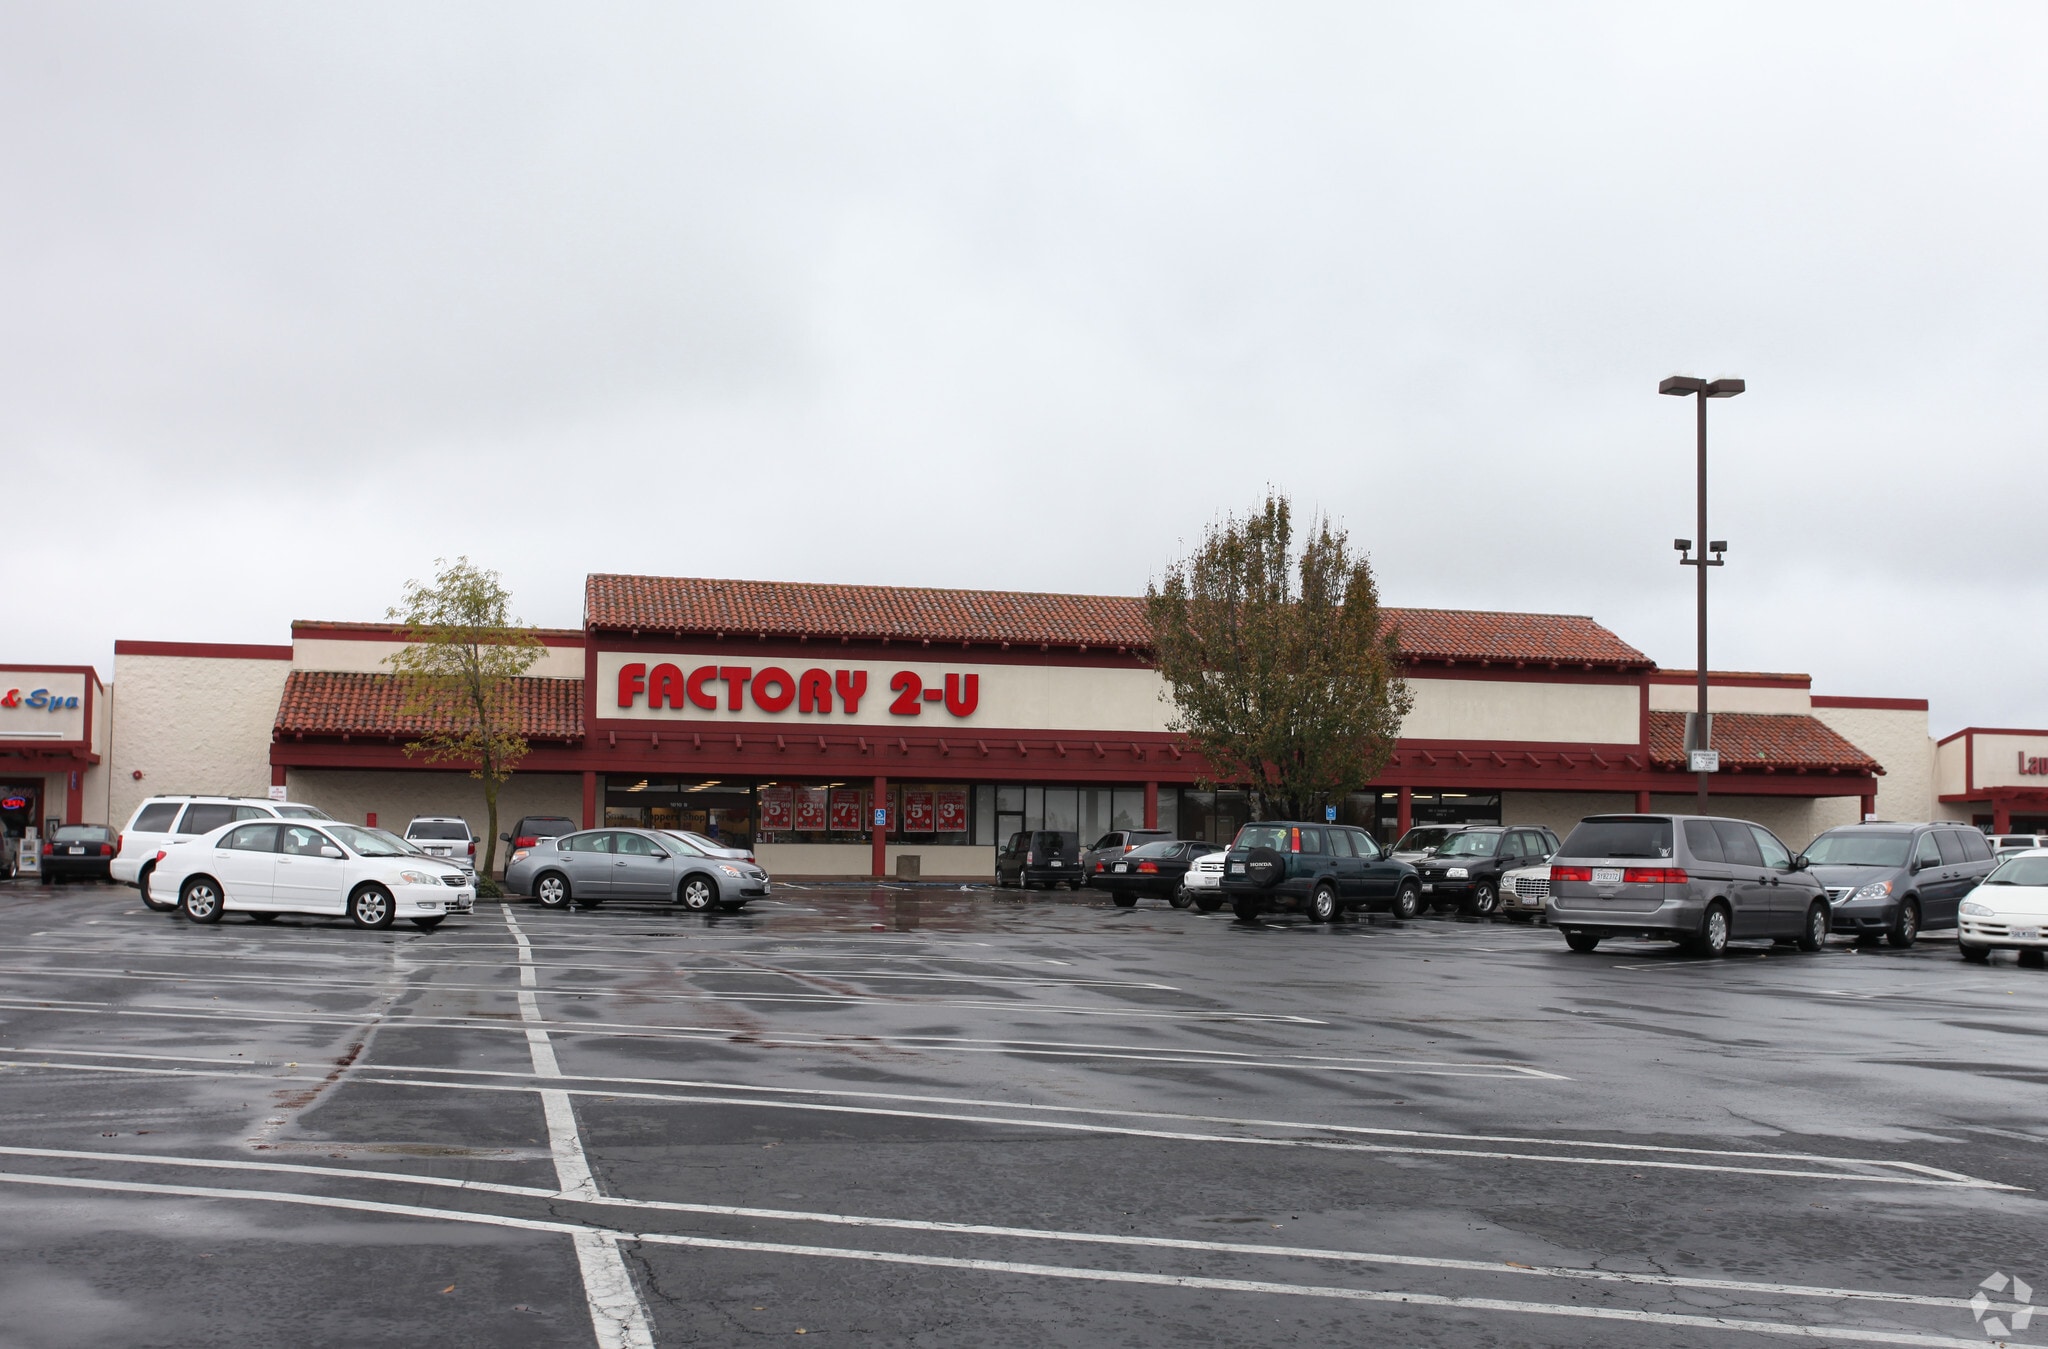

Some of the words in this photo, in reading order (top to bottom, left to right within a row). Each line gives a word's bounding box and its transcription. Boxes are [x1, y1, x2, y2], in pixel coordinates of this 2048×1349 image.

[0, 688, 22, 708] &
[25, 688, 79, 713] Spa
[617, 662, 868, 714] FACTORY
[888, 670, 980, 718] 2-U
[2, 799, 25, 808] OPEN
